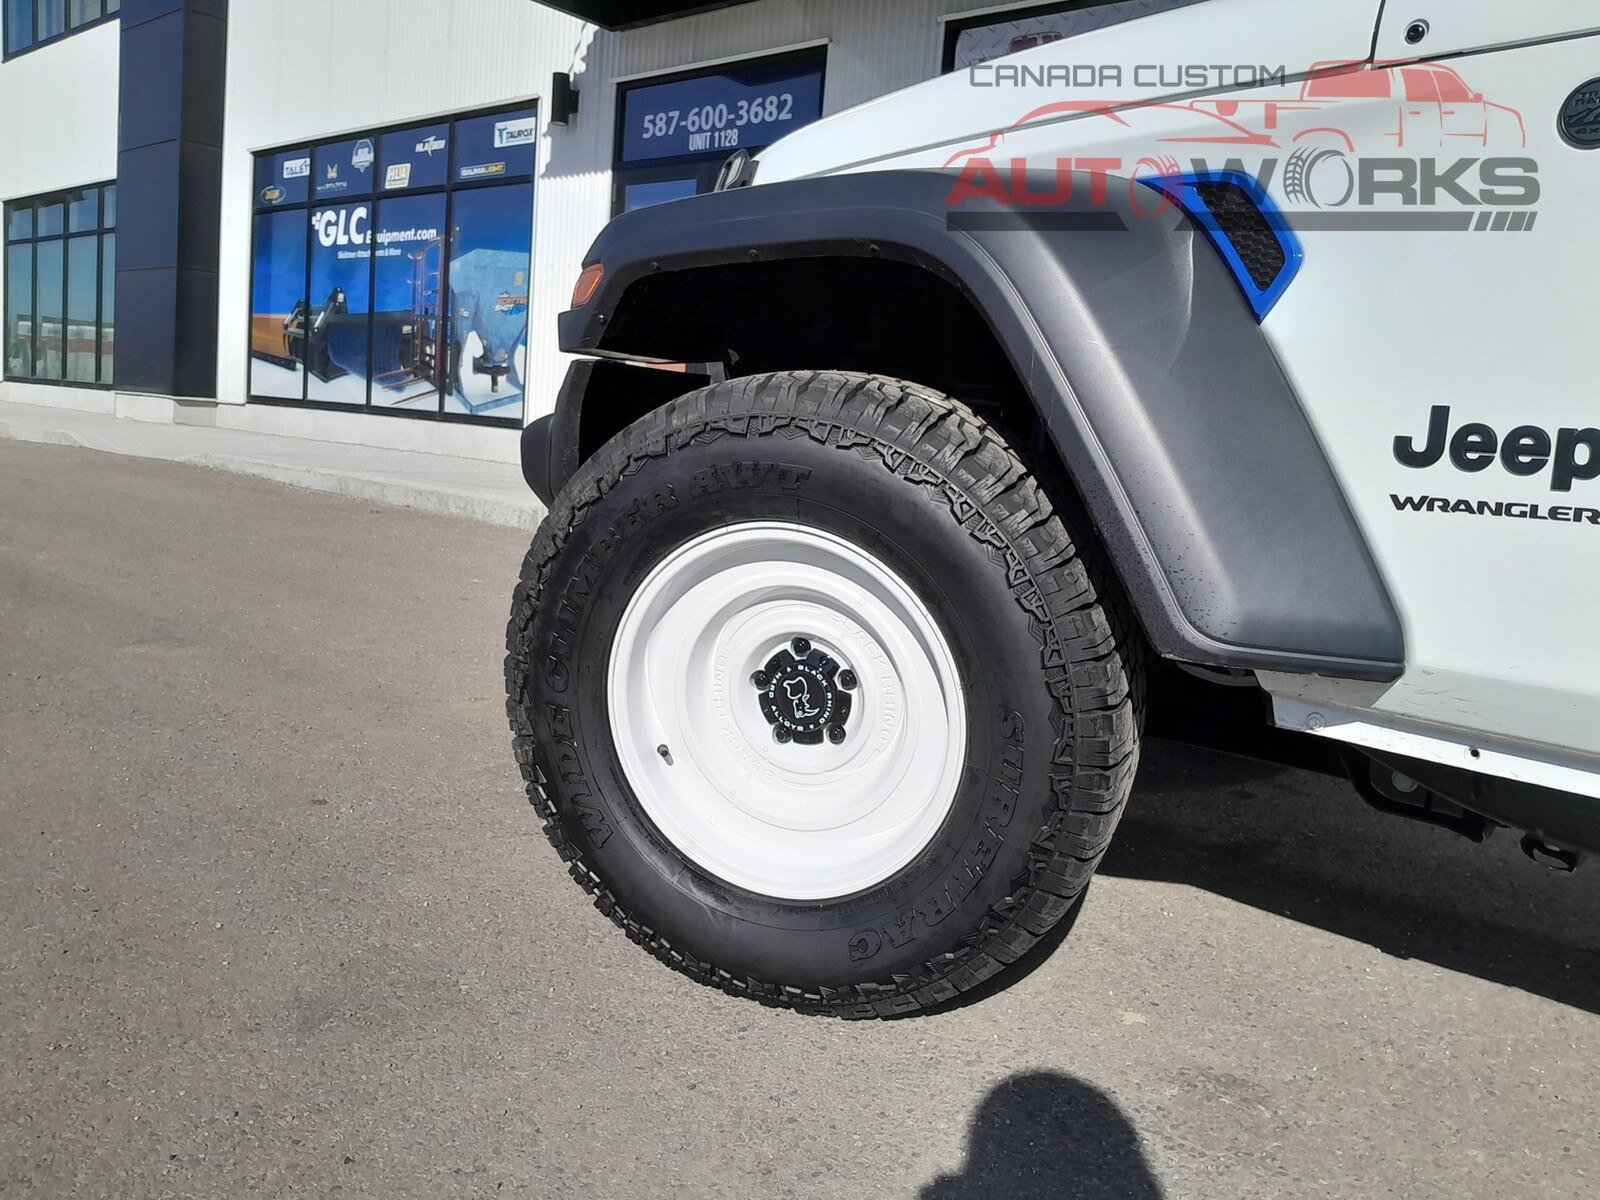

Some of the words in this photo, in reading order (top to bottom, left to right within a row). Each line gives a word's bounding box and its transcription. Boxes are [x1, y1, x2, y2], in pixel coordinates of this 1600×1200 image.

[505, 127, 534, 141] TAUROX
[641, 93, 794, 140] 587-600-3682
[689, 132, 712, 152] UNIT
[713, 128, 739, 149] 1128
[318, 206, 368, 247] GLC
[366, 227, 437, 246] Euipment.com
[1392, 404, 1600, 493] Jeep
[690, 461, 813, 496] AWT
[1389, 493, 1600, 526] WRANGLER
[545, 482, 681, 694] CLIMBER
[768, 672, 782, 699] HARD
[797, 664, 828, 688] BLACK
[819, 692, 833, 725] RHINO
[770, 704, 804, 731] ALLOYS
[546, 702, 614, 850] WIDE
